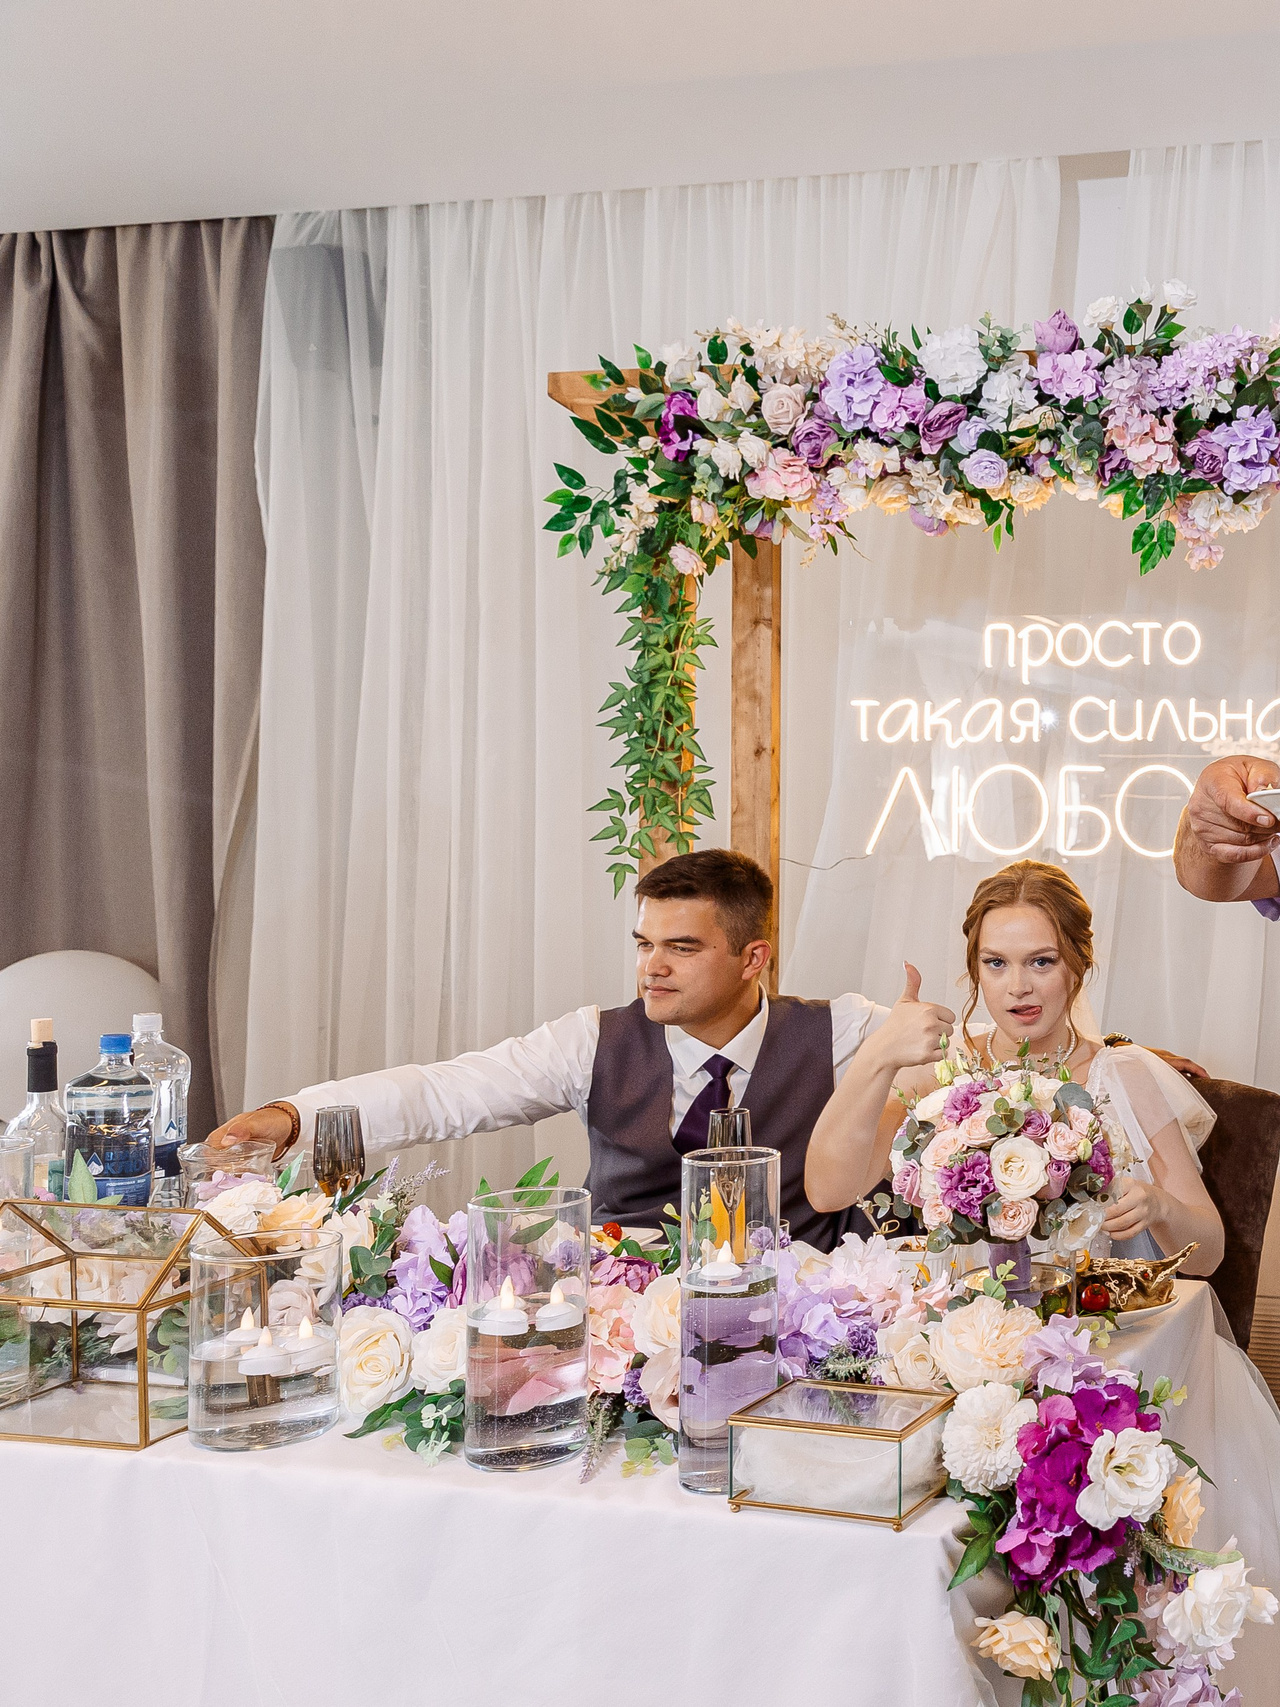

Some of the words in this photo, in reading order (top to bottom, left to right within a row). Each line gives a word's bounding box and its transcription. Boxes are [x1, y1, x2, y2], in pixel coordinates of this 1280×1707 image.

[983, 620, 1201, 685] просто
[850, 697, 1041, 749] такая
[865, 764, 1195, 858] ЛЮБО
